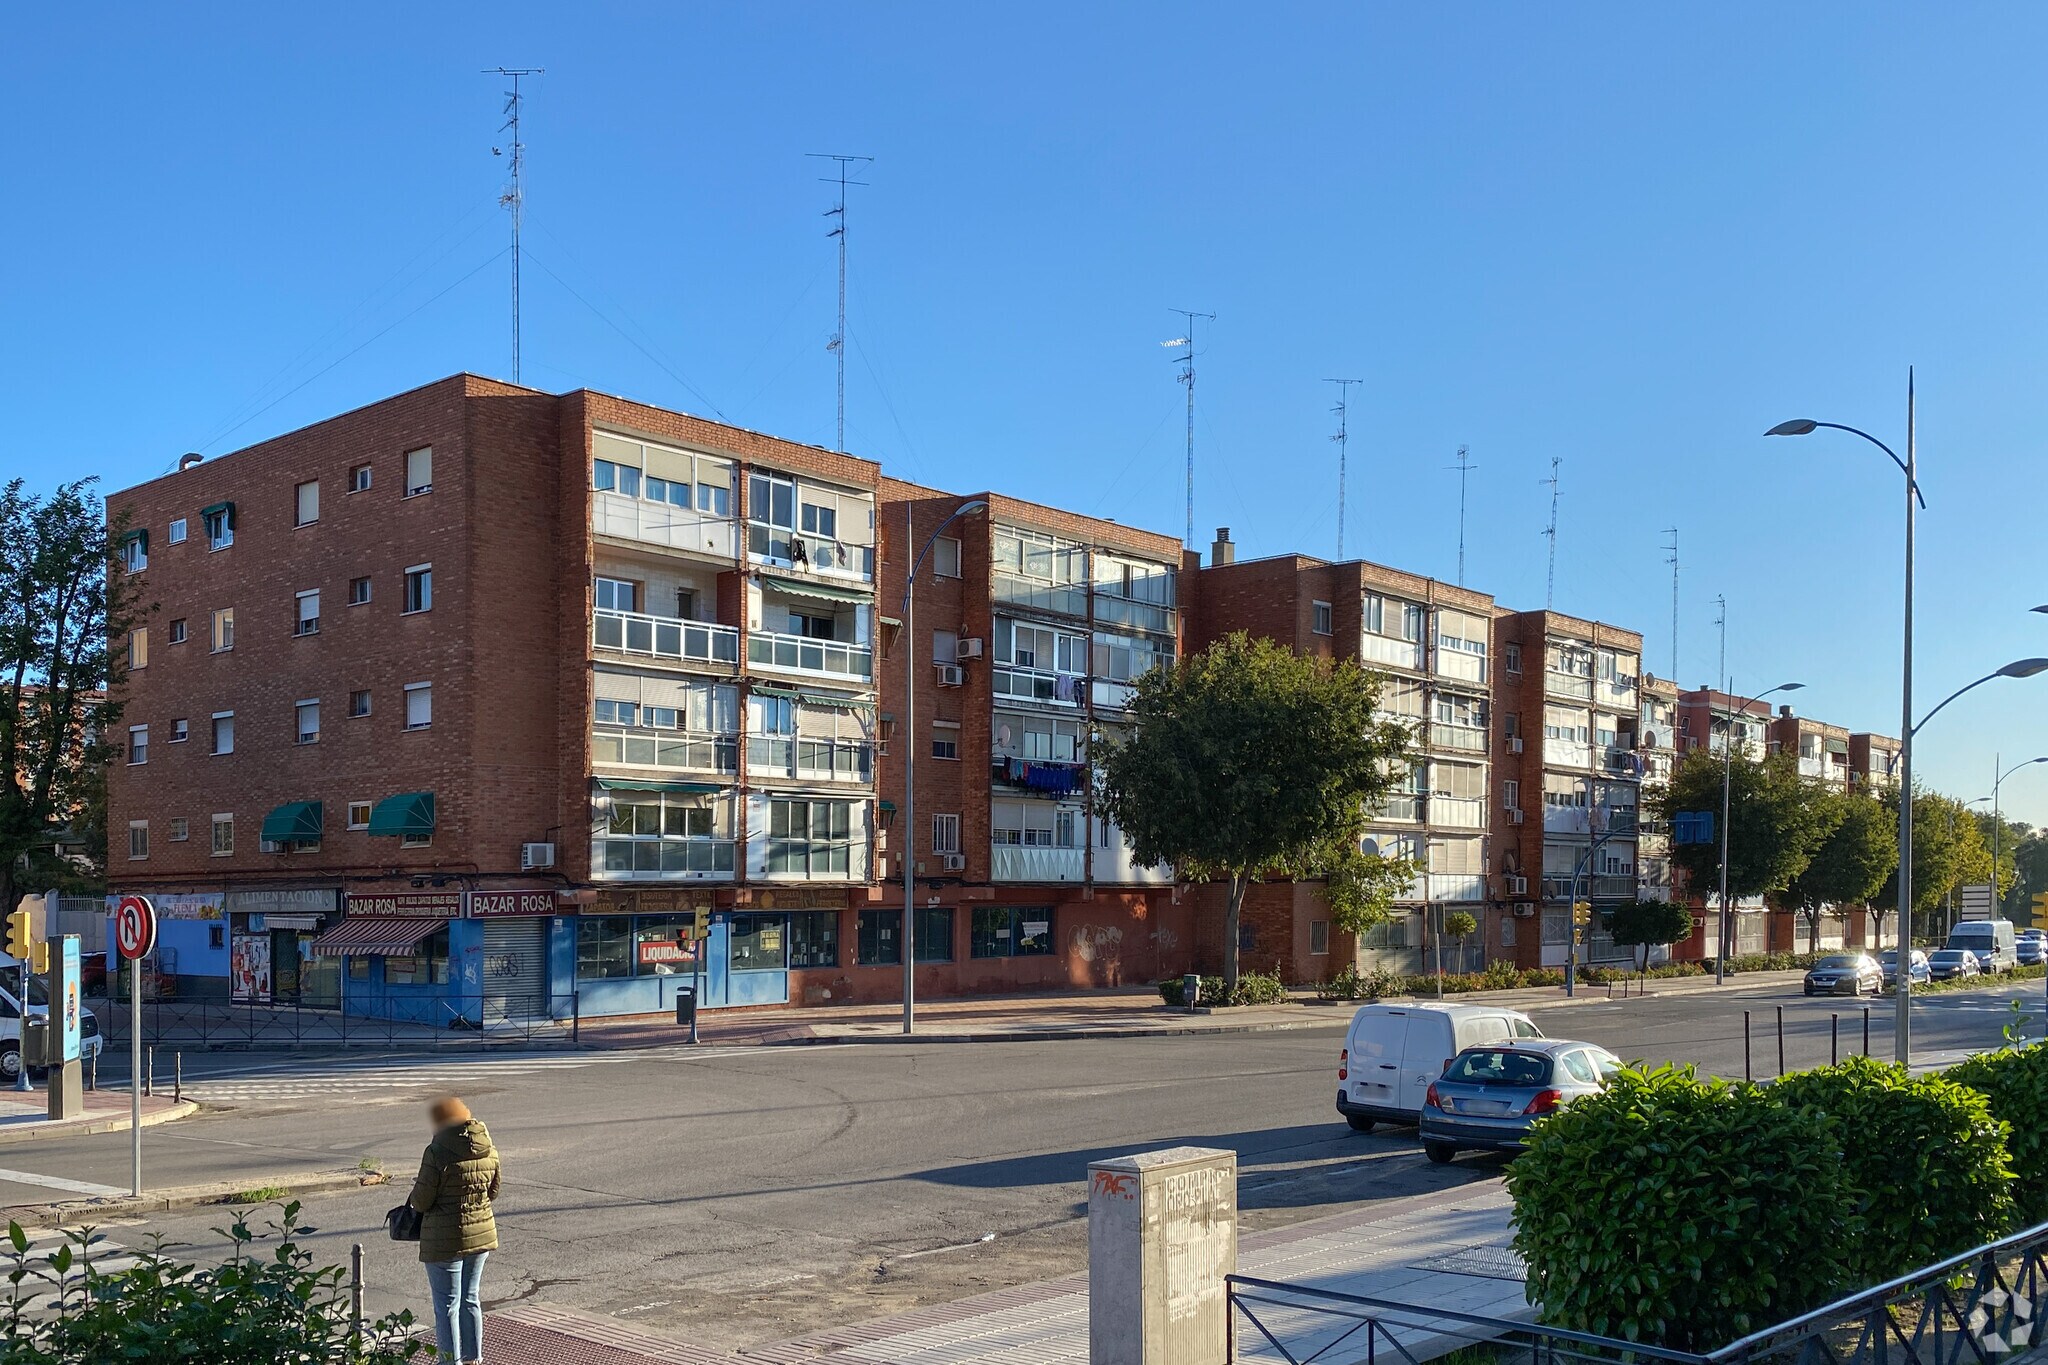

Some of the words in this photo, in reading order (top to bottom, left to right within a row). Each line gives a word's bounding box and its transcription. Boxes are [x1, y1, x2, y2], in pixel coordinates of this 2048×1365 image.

[239, 890, 323, 904] ALIMENTACION
[474, 896, 515, 913] BAZAR
[521, 895, 554, 912] ROSA
[349, 899, 374, 915] BAZAR
[376, 899, 397, 915] ROSA
[643, 943, 698, 961] LIQUIDACIÓ
